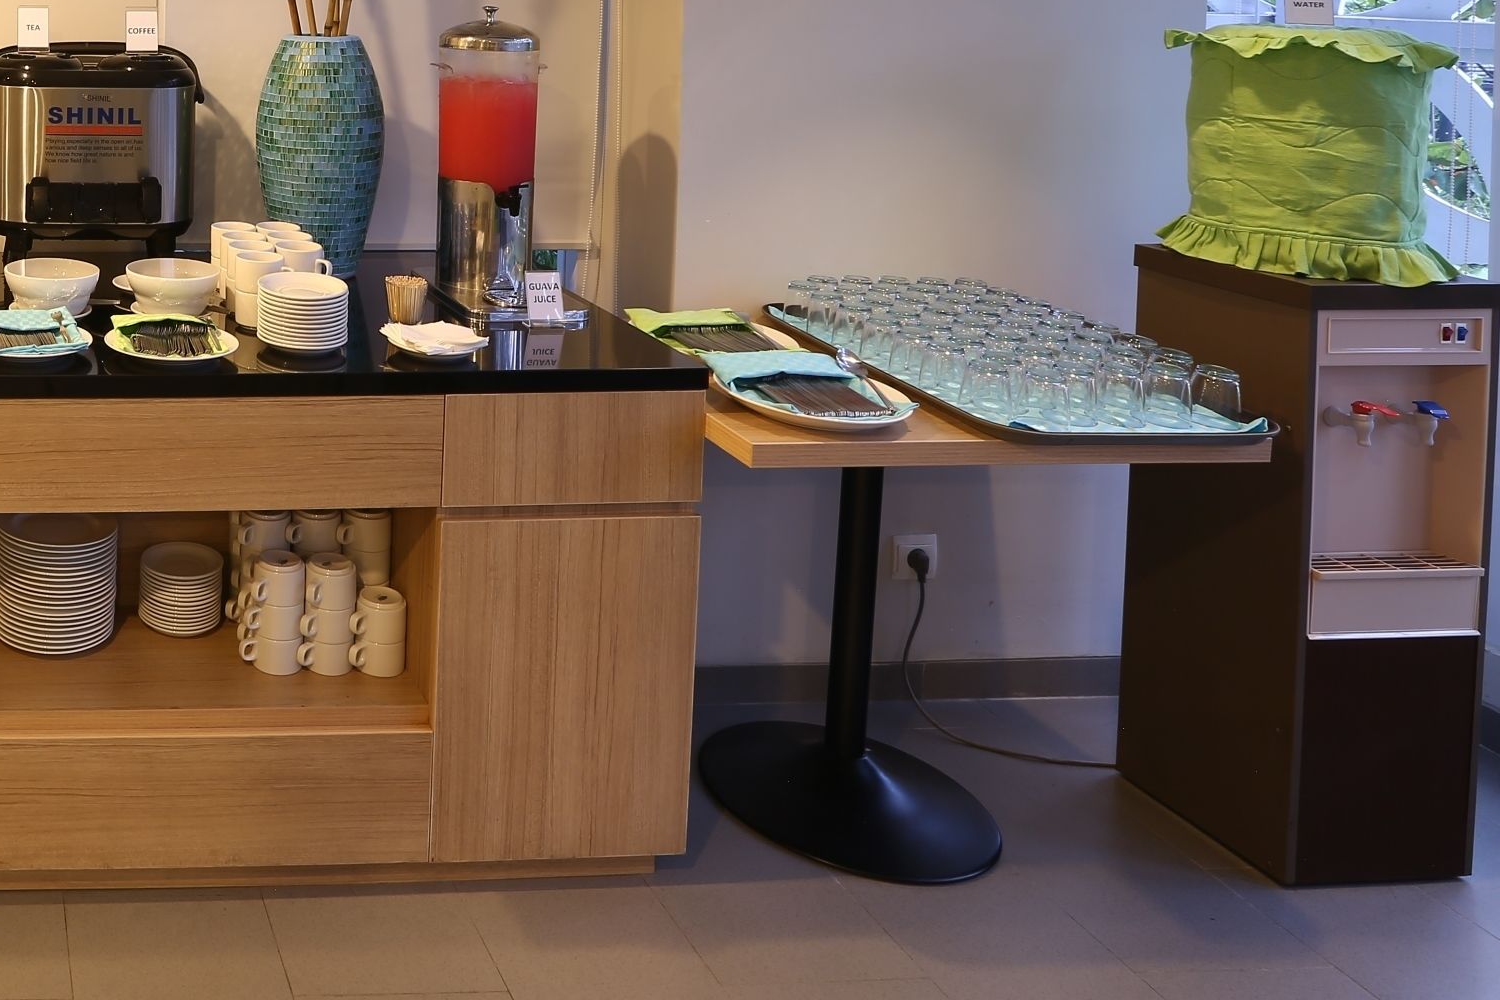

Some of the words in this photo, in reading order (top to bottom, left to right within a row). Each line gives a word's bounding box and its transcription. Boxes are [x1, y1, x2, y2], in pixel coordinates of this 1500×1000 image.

[128, 27, 156, 35] COFFEE
[87, 94, 111, 102] SHINIL
[48, 107, 142, 125] SHINIL
[529, 282, 560, 291] GUAVA
[534, 295, 557, 303] JUICE
